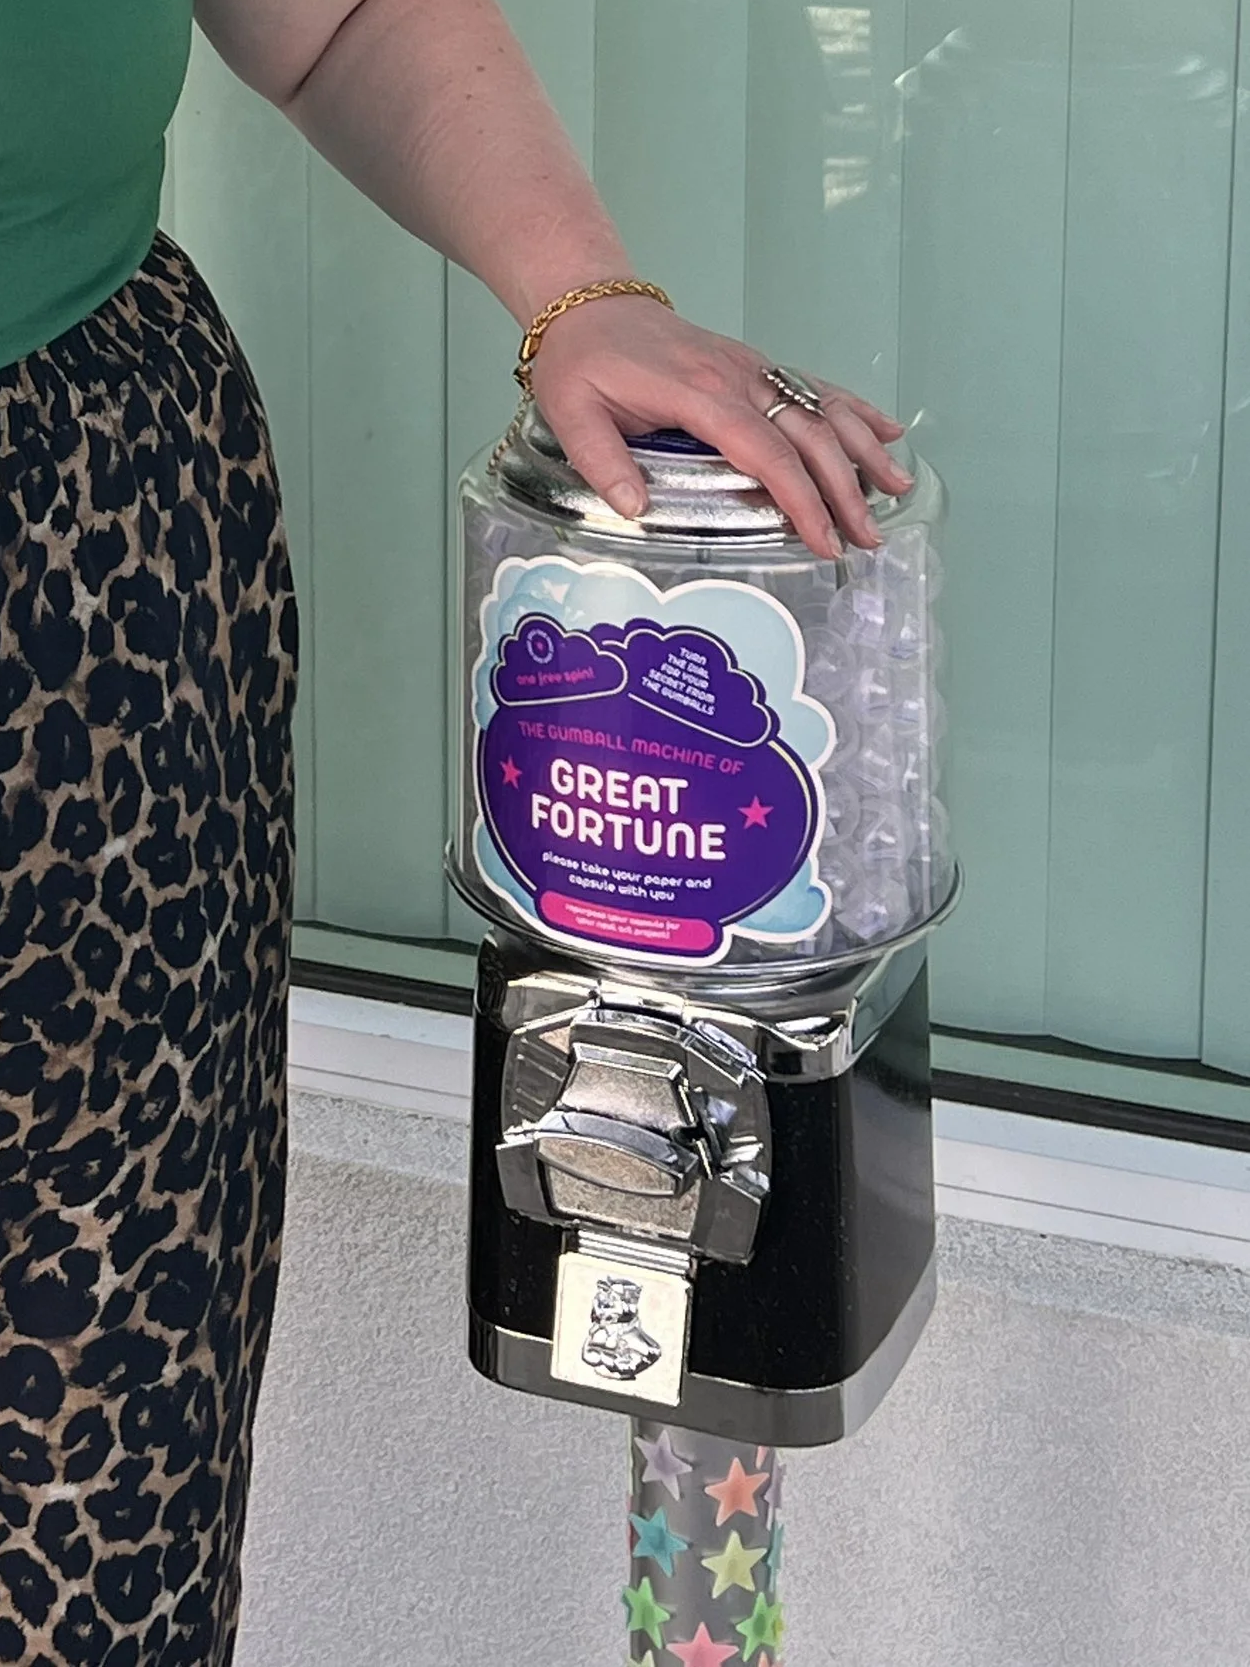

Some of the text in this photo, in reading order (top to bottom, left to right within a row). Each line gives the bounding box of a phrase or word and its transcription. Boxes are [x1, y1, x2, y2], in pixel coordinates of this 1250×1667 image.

[667, 653, 709, 680] THE DIAL
[679, 646, 707, 666] TURN
[538, 671, 562, 687] free
[648, 668, 716, 704] SECRET FROM
[660, 662, 709, 690] FOR YOUR
[641, 676, 716, 716] THE GUMBALLS
[518, 720, 745, 776] THE GUMBALL MACHINE OF
[550, 758, 689, 815] GREAT
[531, 793, 727, 861] FORTUNE
[542, 851, 712, 890] please take your paper and
[569, 873, 675, 902] capsule with you
